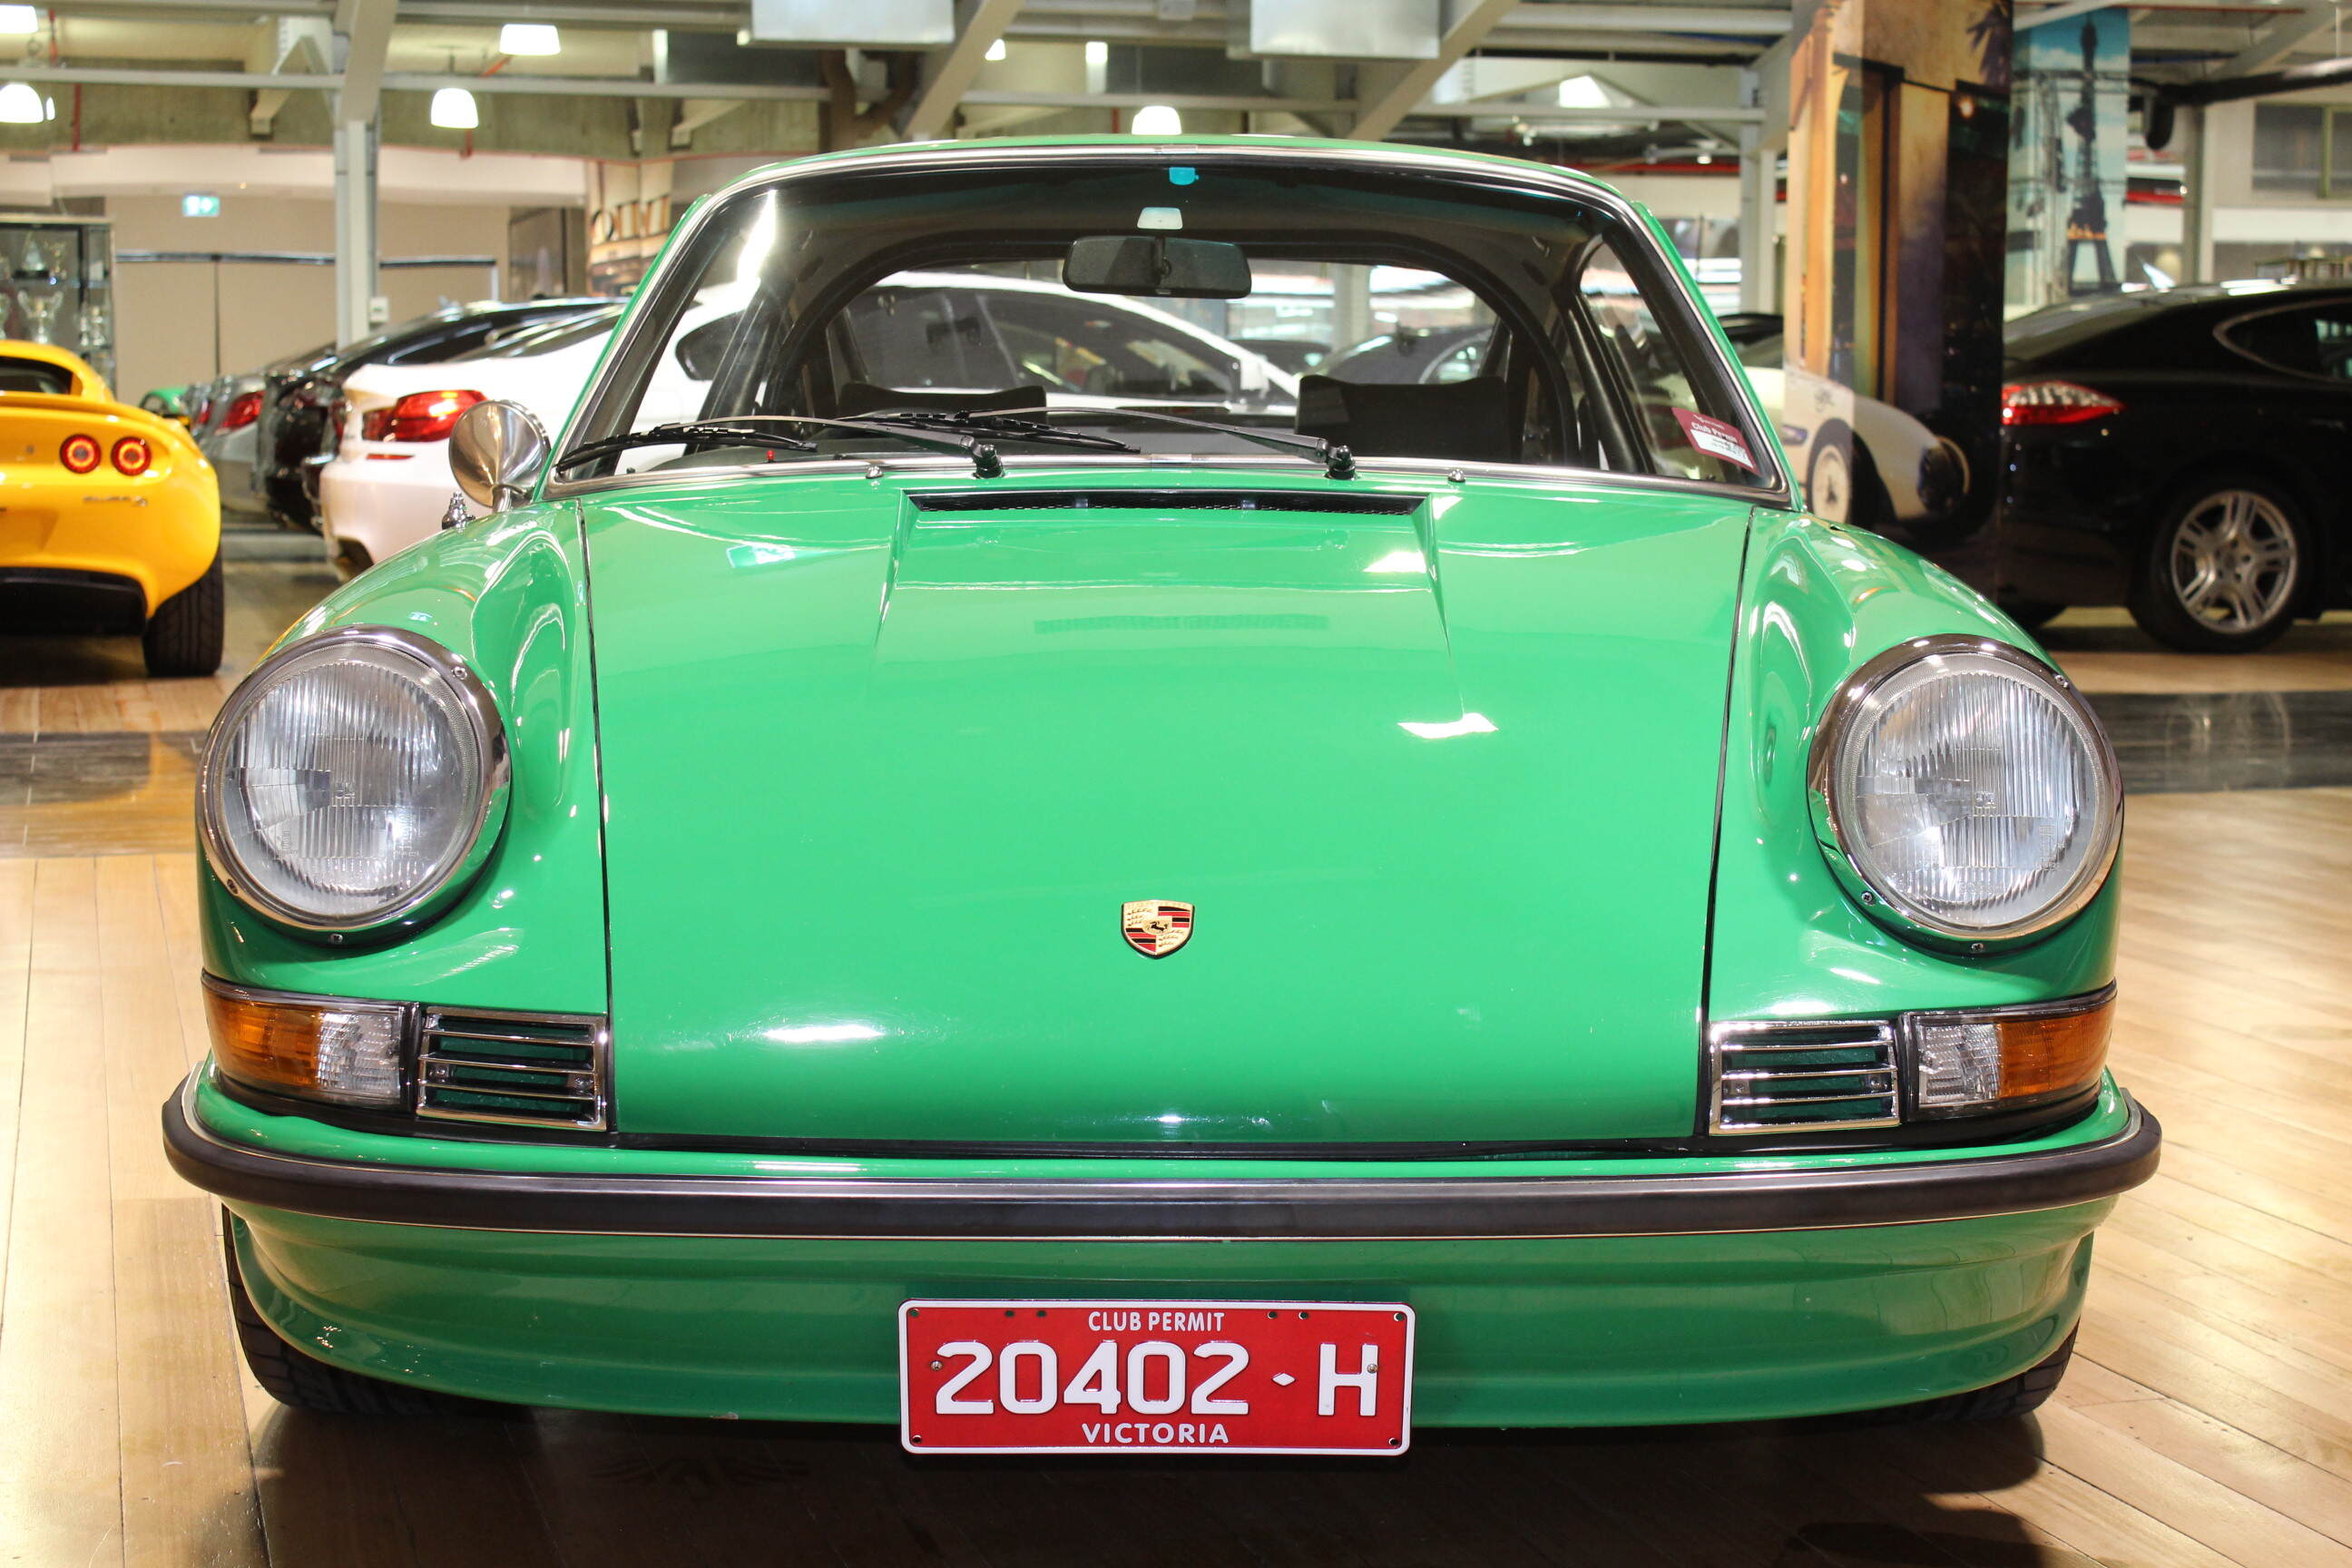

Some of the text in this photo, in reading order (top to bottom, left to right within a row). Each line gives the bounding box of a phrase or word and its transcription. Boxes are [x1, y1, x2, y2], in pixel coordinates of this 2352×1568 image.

[1690, 422, 1712, 434] Club
[1088, 1311, 1225, 1332] CLUB PERMIT
[936, 1340, 1378, 1416] 20402 H
[1082, 1423, 1229, 1444] VICTORIA
